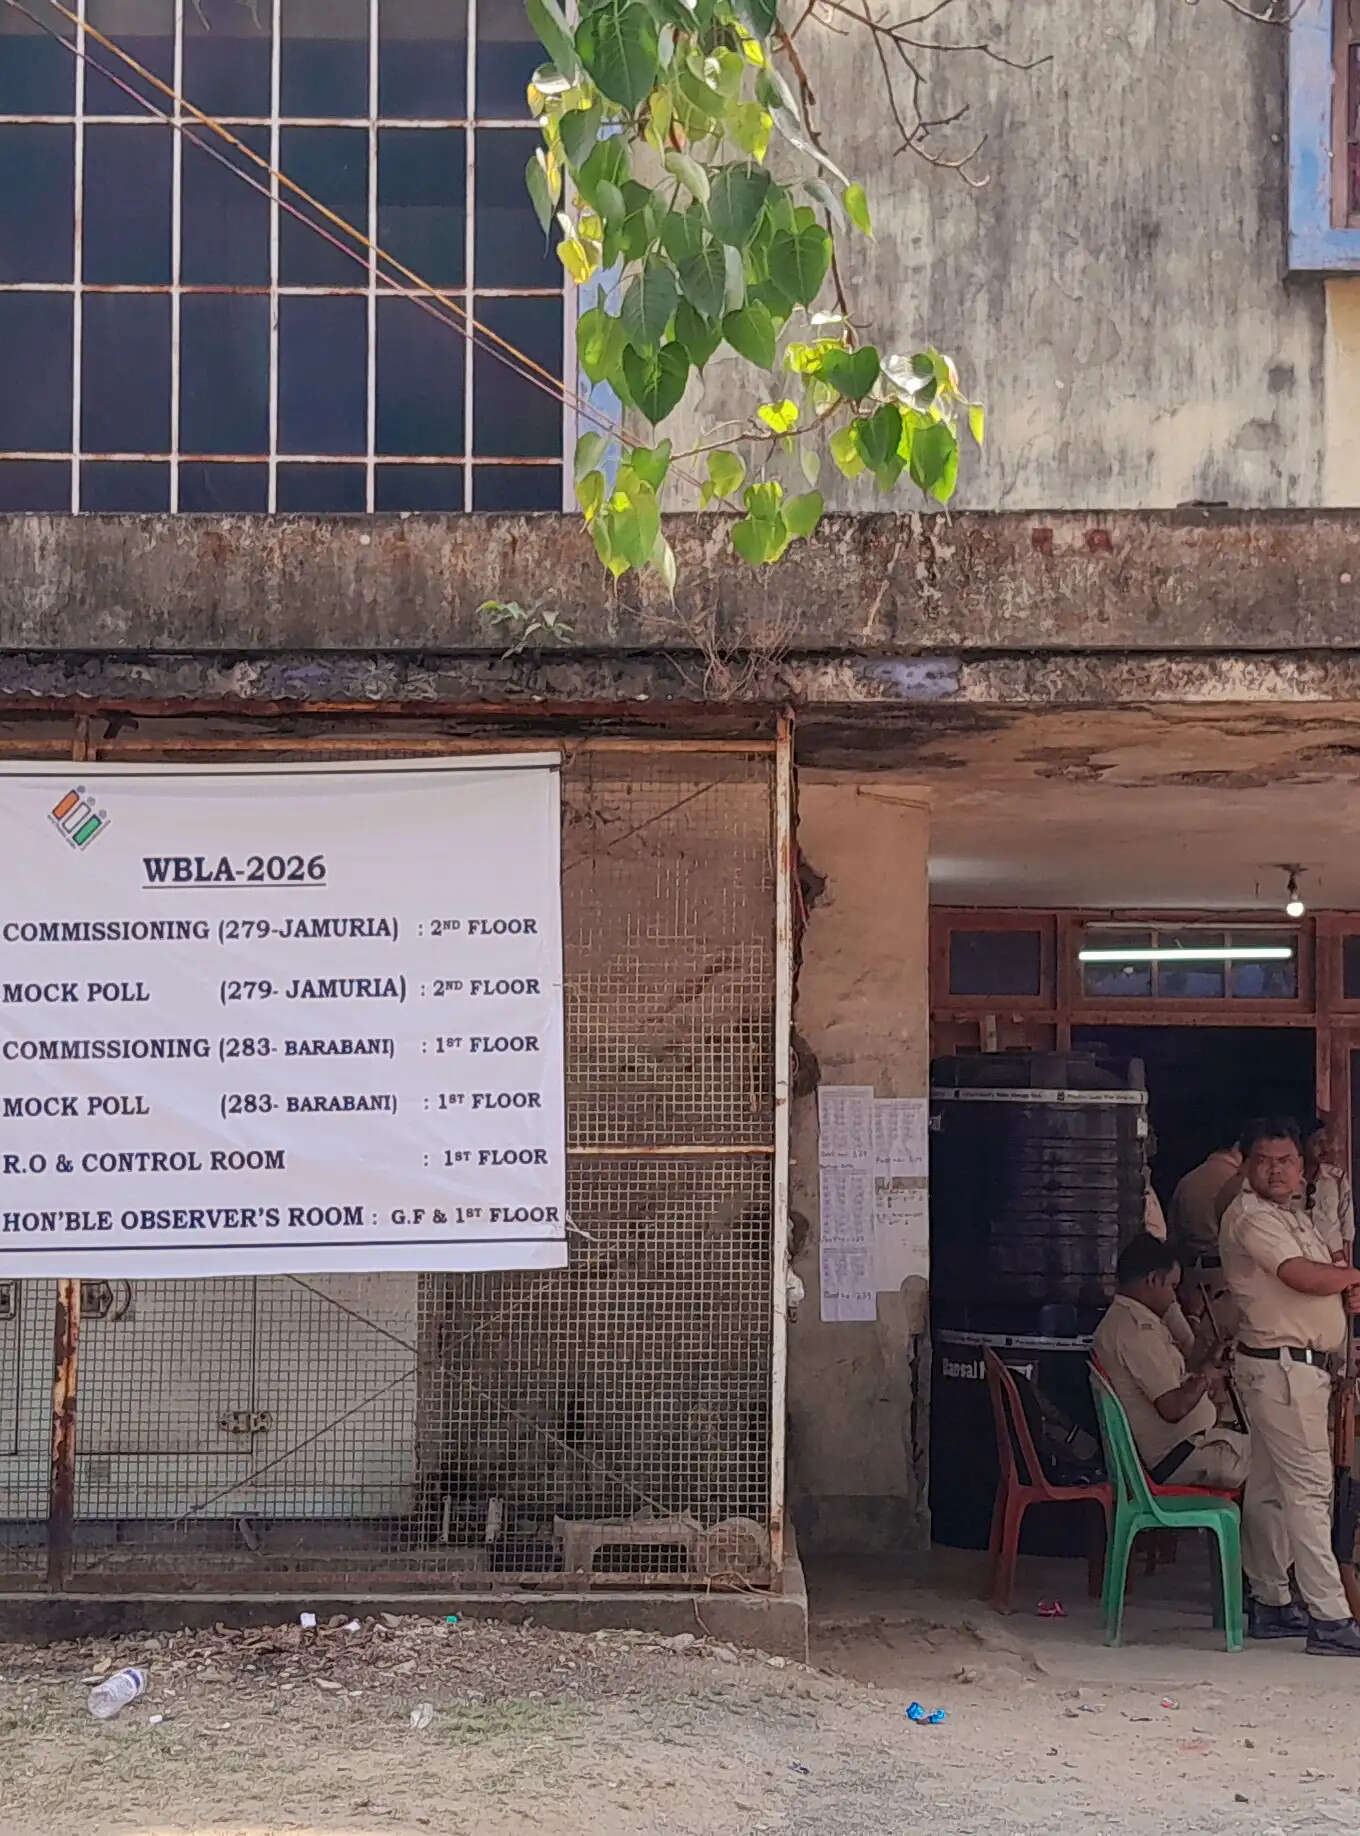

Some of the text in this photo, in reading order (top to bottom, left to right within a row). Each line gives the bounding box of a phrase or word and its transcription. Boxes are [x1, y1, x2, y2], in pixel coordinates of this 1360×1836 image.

[142, 854, 327, 883] WBLA-2026
[3, 919, 210, 942] COMMISSIONING
[218, 917, 399, 944] (279-JAMURIA)
[430, 919, 461, 936] 2ND
[468, 919, 538, 935] FLOOR
[2, 983, 79, 1003] MOCK
[87, 982, 150, 1002] POLL
[220, 980, 279, 1006] (279-
[286, 975, 406, 1003] JAMURIA)
[433, 979, 463, 997] 2ND
[470, 979, 540, 996] FLOOR
[3, 1038, 211, 1060] COMMISSIONING
[218, 1037, 278, 1063] (283-
[285, 1038, 395, 1058] BARABANI)
[436, 1037, 462, 1053] 1ST
[470, 1036, 539, 1053] FLOOR
[2, 1097, 79, 1117] MOCK
[87, 1096, 150, 1116] POLL
[221, 1093, 279, 1119] (283-
[286, 1094, 398, 1114] BARABANI)
[438, 1093, 465, 1109] 1ST
[472, 1093, 541, 1109] FLOOR
[3, 1154, 47, 1173] R.O
[56, 1153, 73, 1172] &
[82, 1151, 202, 1172] CONTROL
[210, 1150, 286, 1170] ROOM
[444, 1150, 472, 1166] 1ST
[478, 1149, 548, 1166] FLOOR
[2, 1211, 112, 1232] HON'BLE
[121, 1207, 280, 1229] OBSERVER'S
[288, 1206, 364, 1227] ROOM
[391, 1209, 425, 1225] G.F
[432, 1209, 447, 1224] &
[455, 1207, 482, 1223] 1ST
[489, 1206, 559, 1223] FLOOR
